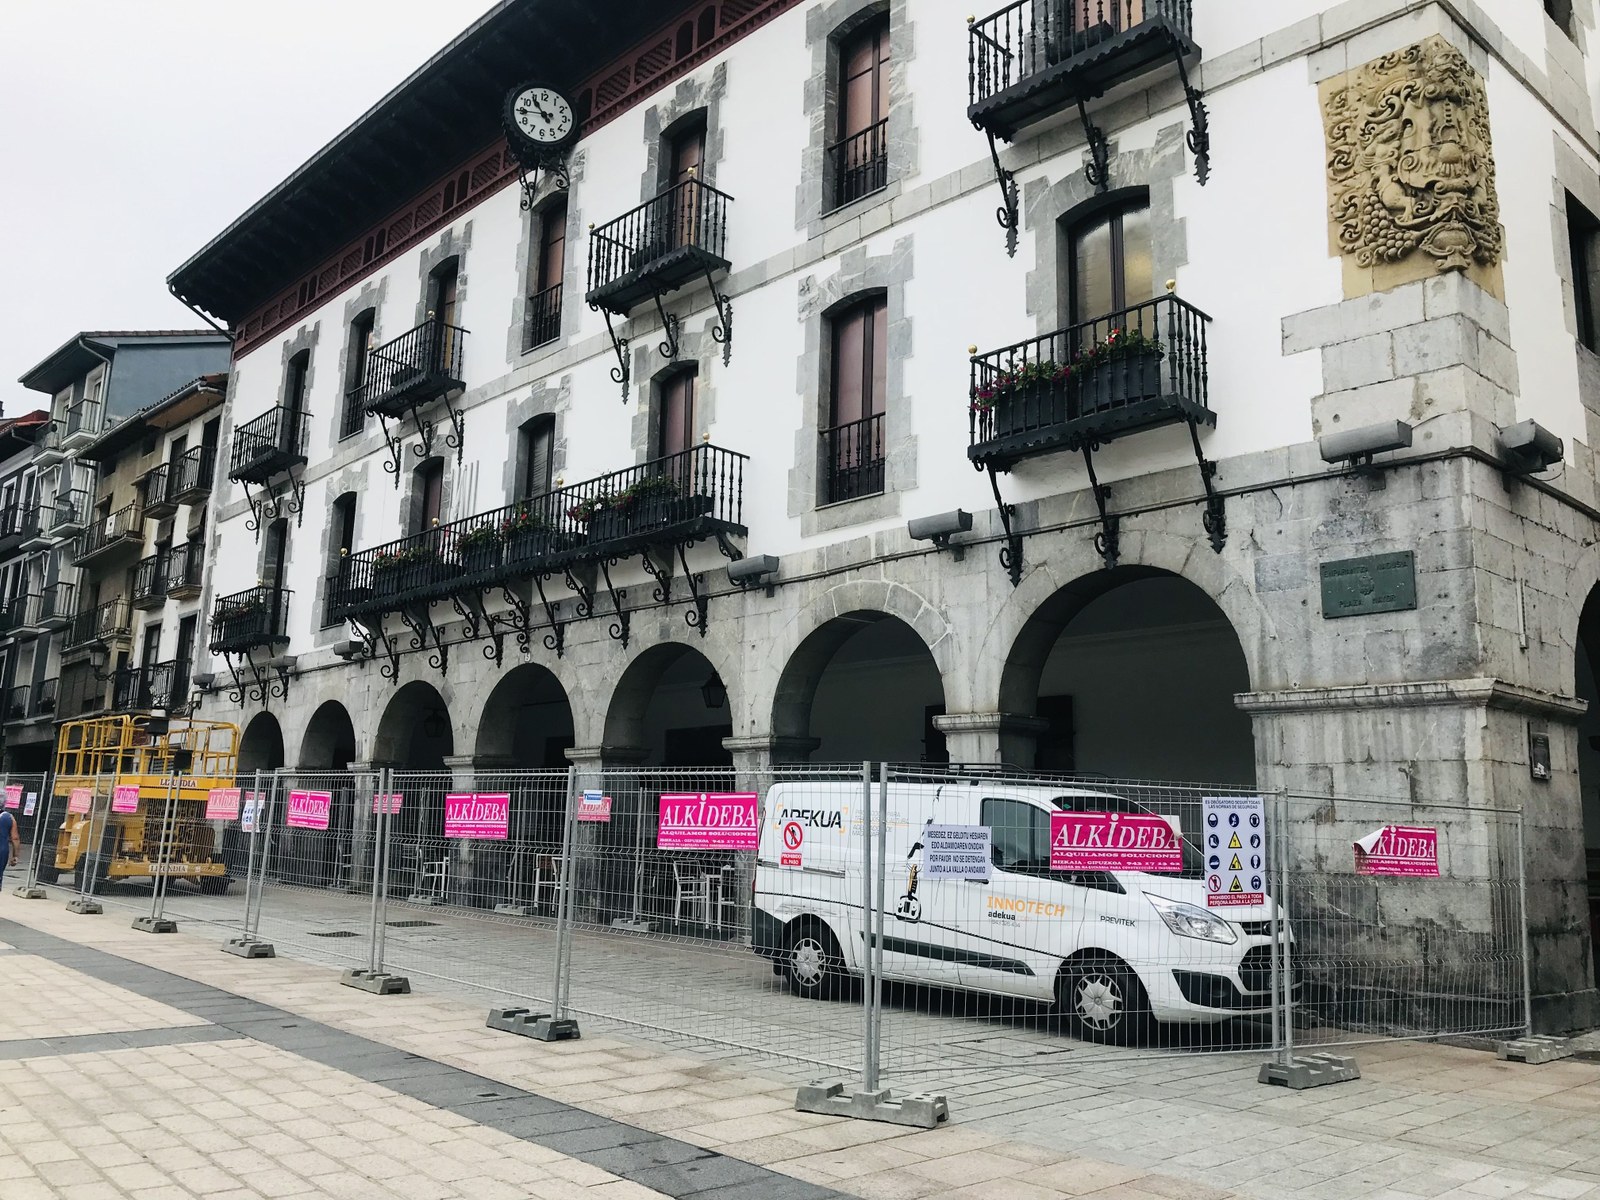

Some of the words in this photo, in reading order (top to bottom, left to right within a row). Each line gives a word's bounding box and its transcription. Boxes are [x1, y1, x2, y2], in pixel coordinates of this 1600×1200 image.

[540, 92, 549, 102] 12
[524, 98, 532, 106] 10
[559, 106, 565, 114] 2
[522, 117, 528, 125] 8
[562, 116, 567, 124] 3
[530, 124, 536, 132] 7
[550, 128, 556, 136] 5
[558, 124, 564, 132] 4
[965, 855, 986, 863] DETENGAN
[986, 896, 1066, 917] INNOTECH
[1100, 915, 1136, 927] PREVITEK
